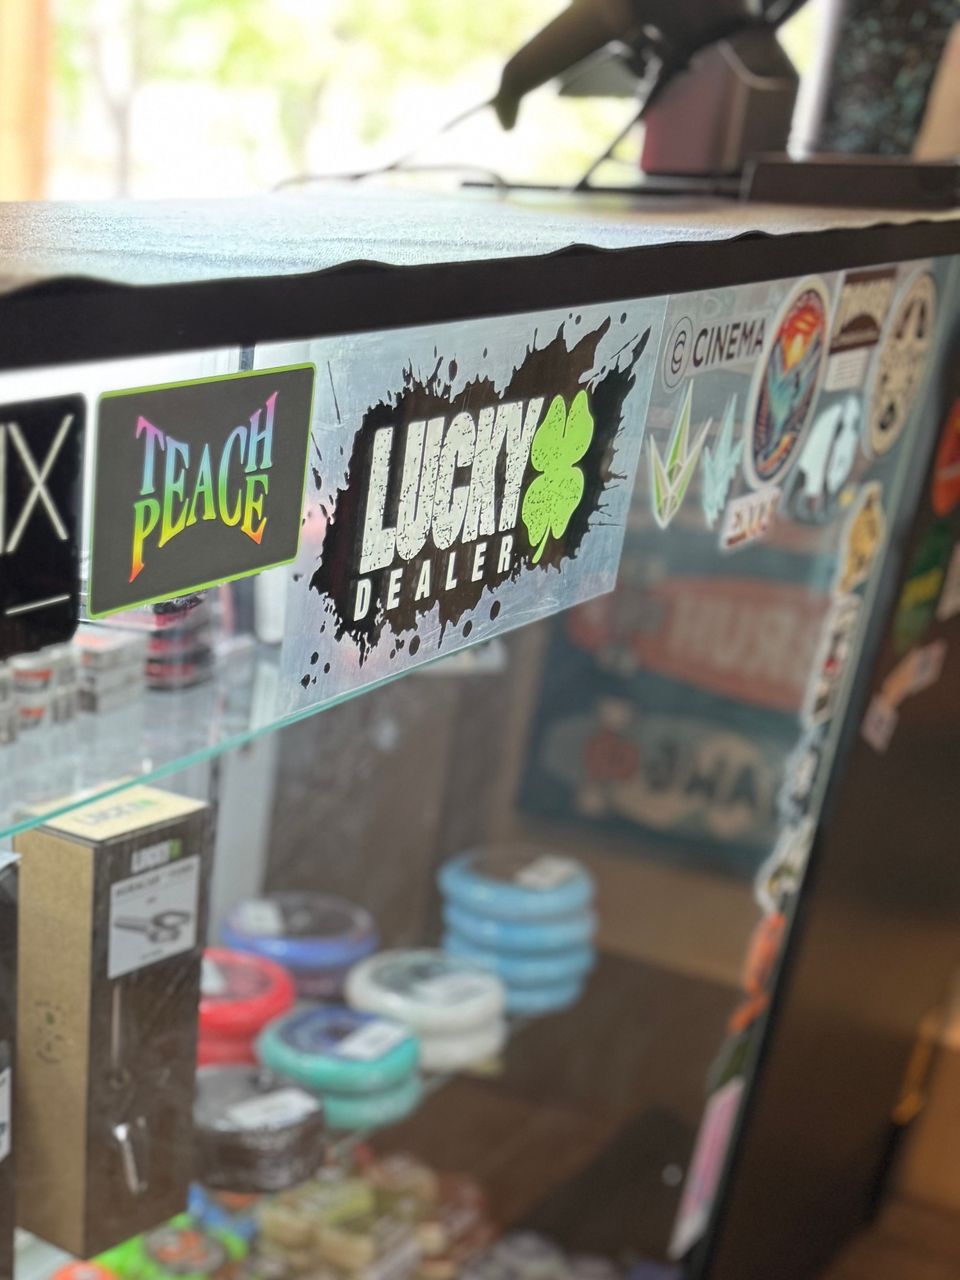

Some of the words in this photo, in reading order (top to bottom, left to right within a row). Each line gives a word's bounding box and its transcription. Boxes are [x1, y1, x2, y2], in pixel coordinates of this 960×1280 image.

[693, 318, 766, 368] CINEMA
[135, 391, 279, 515] TEACH
[359, 397, 544, 574] LUCKY
[129, 460, 269, 584] PEACE
[353, 535, 514, 621] DEALER
